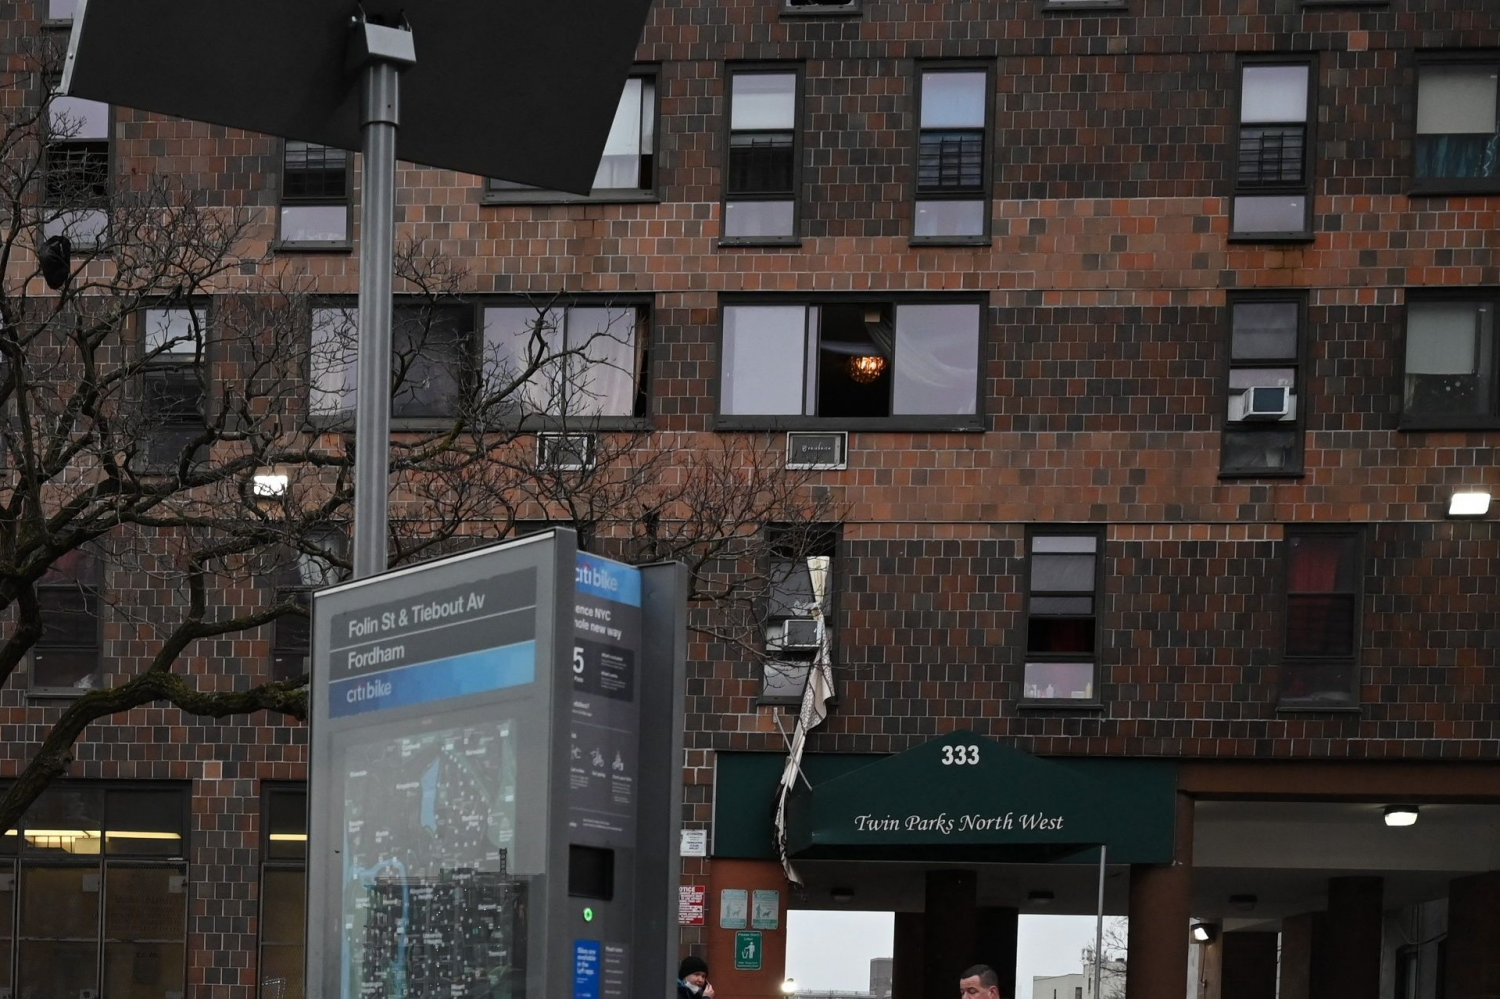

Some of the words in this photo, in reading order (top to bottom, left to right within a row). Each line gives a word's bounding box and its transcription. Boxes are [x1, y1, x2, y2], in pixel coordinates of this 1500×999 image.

[593, 568, 618, 591] bike
[349, 618, 378, 638] Folin
[381, 611, 396, 631] St
[398, 608, 408, 627] &
[411, 595, 464, 624] Tiebout
[466, 592, 486, 612] Av
[595, 608, 611, 621] NYC
[590, 622, 607, 635] new
[607, 629, 622, 641] way
[347, 645, 405, 669] Fordham
[346, 684, 366, 703] citi
[366, 679, 392, 700] bike
[941, 745, 980, 765] 333
[854, 813, 900, 832] Twin
[904, 812, 954, 835] Parks
[958, 812, 1014, 832] North
[1018, 812, 1064, 830] West
